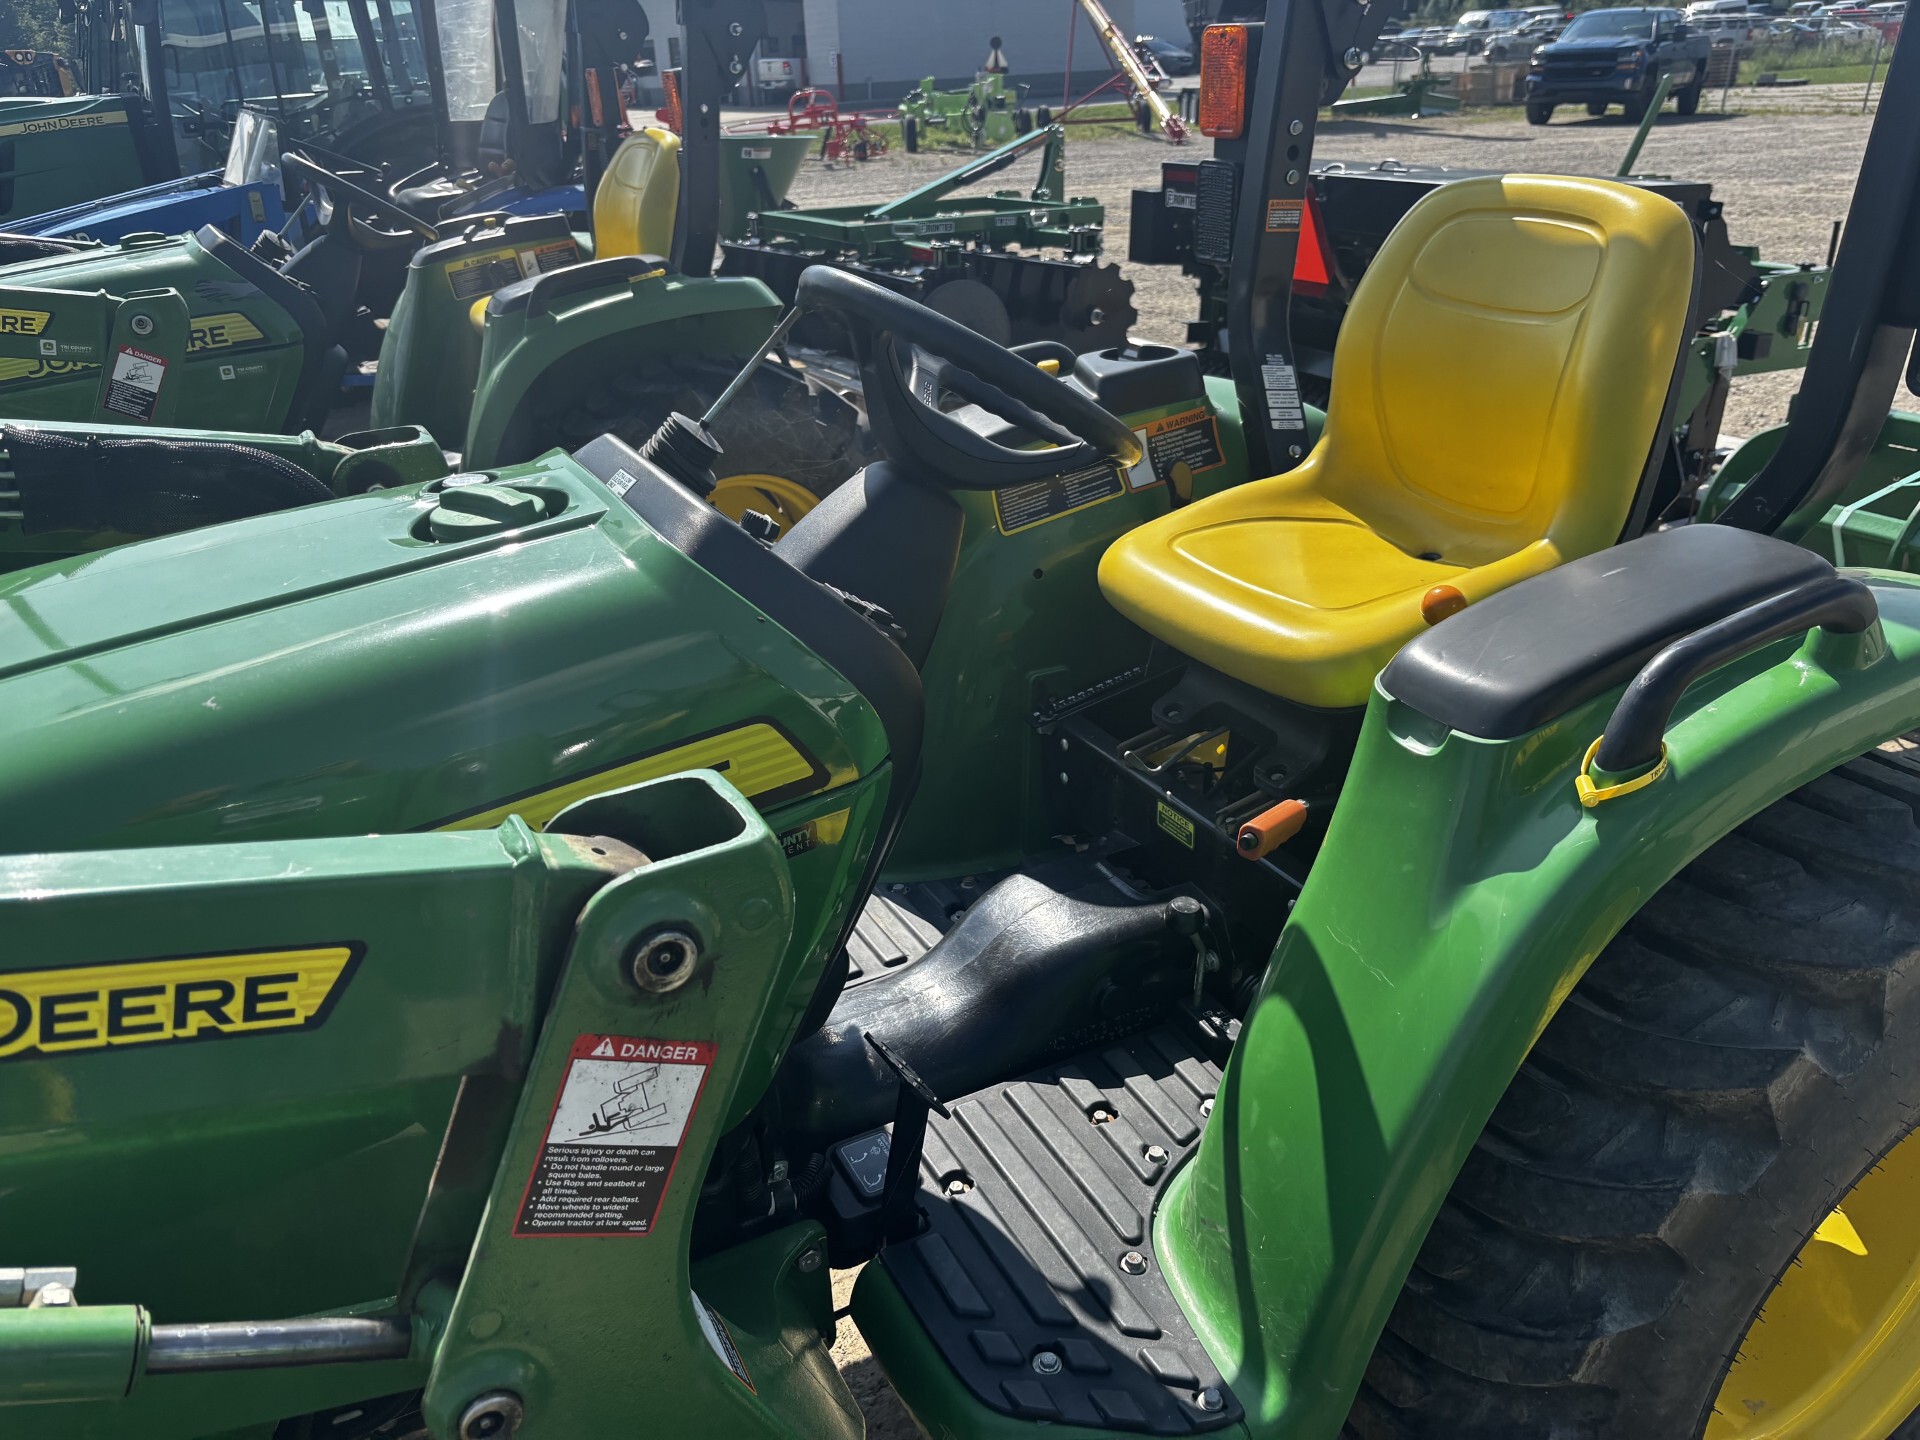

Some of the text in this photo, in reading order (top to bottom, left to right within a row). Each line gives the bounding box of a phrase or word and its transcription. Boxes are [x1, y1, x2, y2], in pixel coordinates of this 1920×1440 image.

[21, 116, 105, 134] JOHN DEERE
[471, 255, 500, 265] CAUTION
[134, 351, 163, 364] DANGER
[1166, 411, 1205, 429] WARNING
[1162, 806, 1190, 830] NOTICE
[620, 1044, 698, 1060] DANGER
[581, 1147, 604, 1156] injury
[645, 1165, 665, 1173] large
[532, 1219, 565, 1227] Operate
[622, 1219, 647, 1227] speed.
